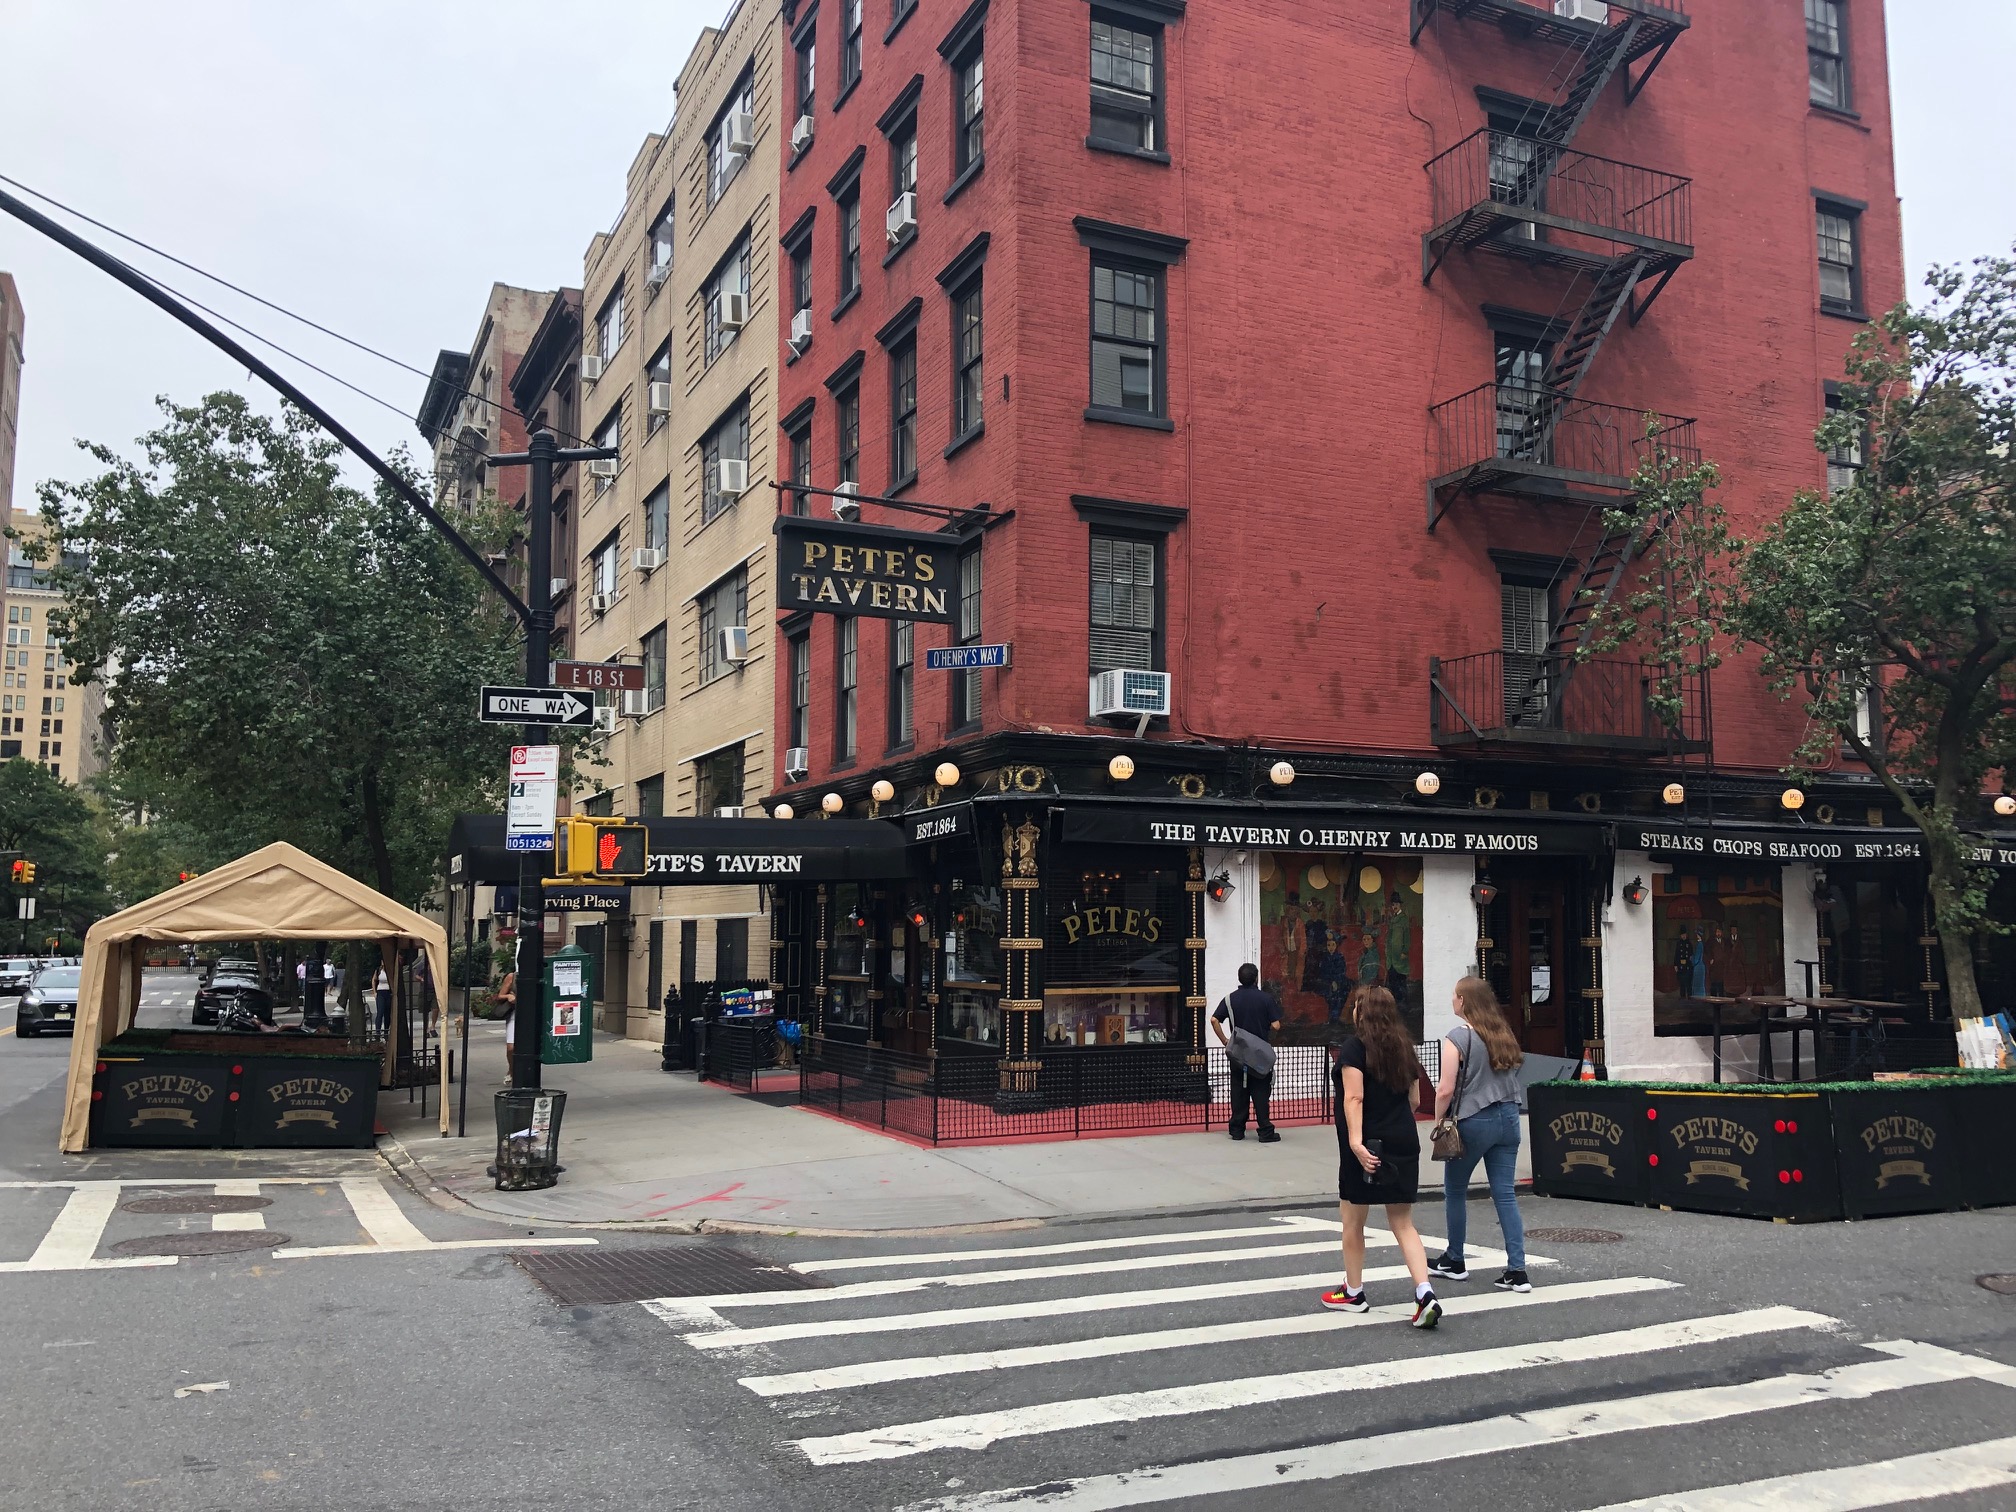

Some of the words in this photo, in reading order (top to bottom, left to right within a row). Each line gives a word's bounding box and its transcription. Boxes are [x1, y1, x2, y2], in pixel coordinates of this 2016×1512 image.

[803, 541, 934, 581] PETE'S
[792, 573, 947, 614] TAVERN
[933, 648, 977, 667] O'HENRY'S
[980, 647, 999, 664] WAY
[573, 668, 580, 684] E
[586, 669, 602, 686] 18
[610, 670, 624, 686] St
[498, 698, 530, 712] ONE
[546, 700, 578, 714] WAY
[513, 782, 522, 796] 2
[916, 816, 957, 840] EST.1864
[1150, 823, 1196, 842] THE
[1206, 826, 1290, 845] TAVERN
[1300, 829, 1391, 848] O.HENRY
[1400, 832, 1456, 849] MADE
[1464, 834, 1539, 851] FAMOUS
[1640, 833, 1704, 852] STEAKS
[1712, 838, 1763, 856] CHOPS
[1769, 842, 1842, 858] SEAFOOD
[1855, 842, 1921, 858] EST.1864
[646, 854, 704, 873] ETE'S
[716, 854, 802, 873] TAVERN
[544, 895, 580, 910] rving
[584, 894, 620, 908] Place
[1061, 906, 1162, 944] PETE'S
[122, 1074, 214, 1102] PETE'S
[146, 1096, 184, 1104] TAVERN
[266, 1078, 354, 1104] PETE'S
[1548, 1111, 1624, 1146] PETE'S
[1670, 1116, 1759, 1155] PETE'S
[1860, 1116, 1936, 1153] PETE'S
[1569, 1138, 1600, 1147] TAVERN
[1694, 1146, 1731, 1156] TAVERN
[1882, 1146, 1915, 1154] TAVERN
